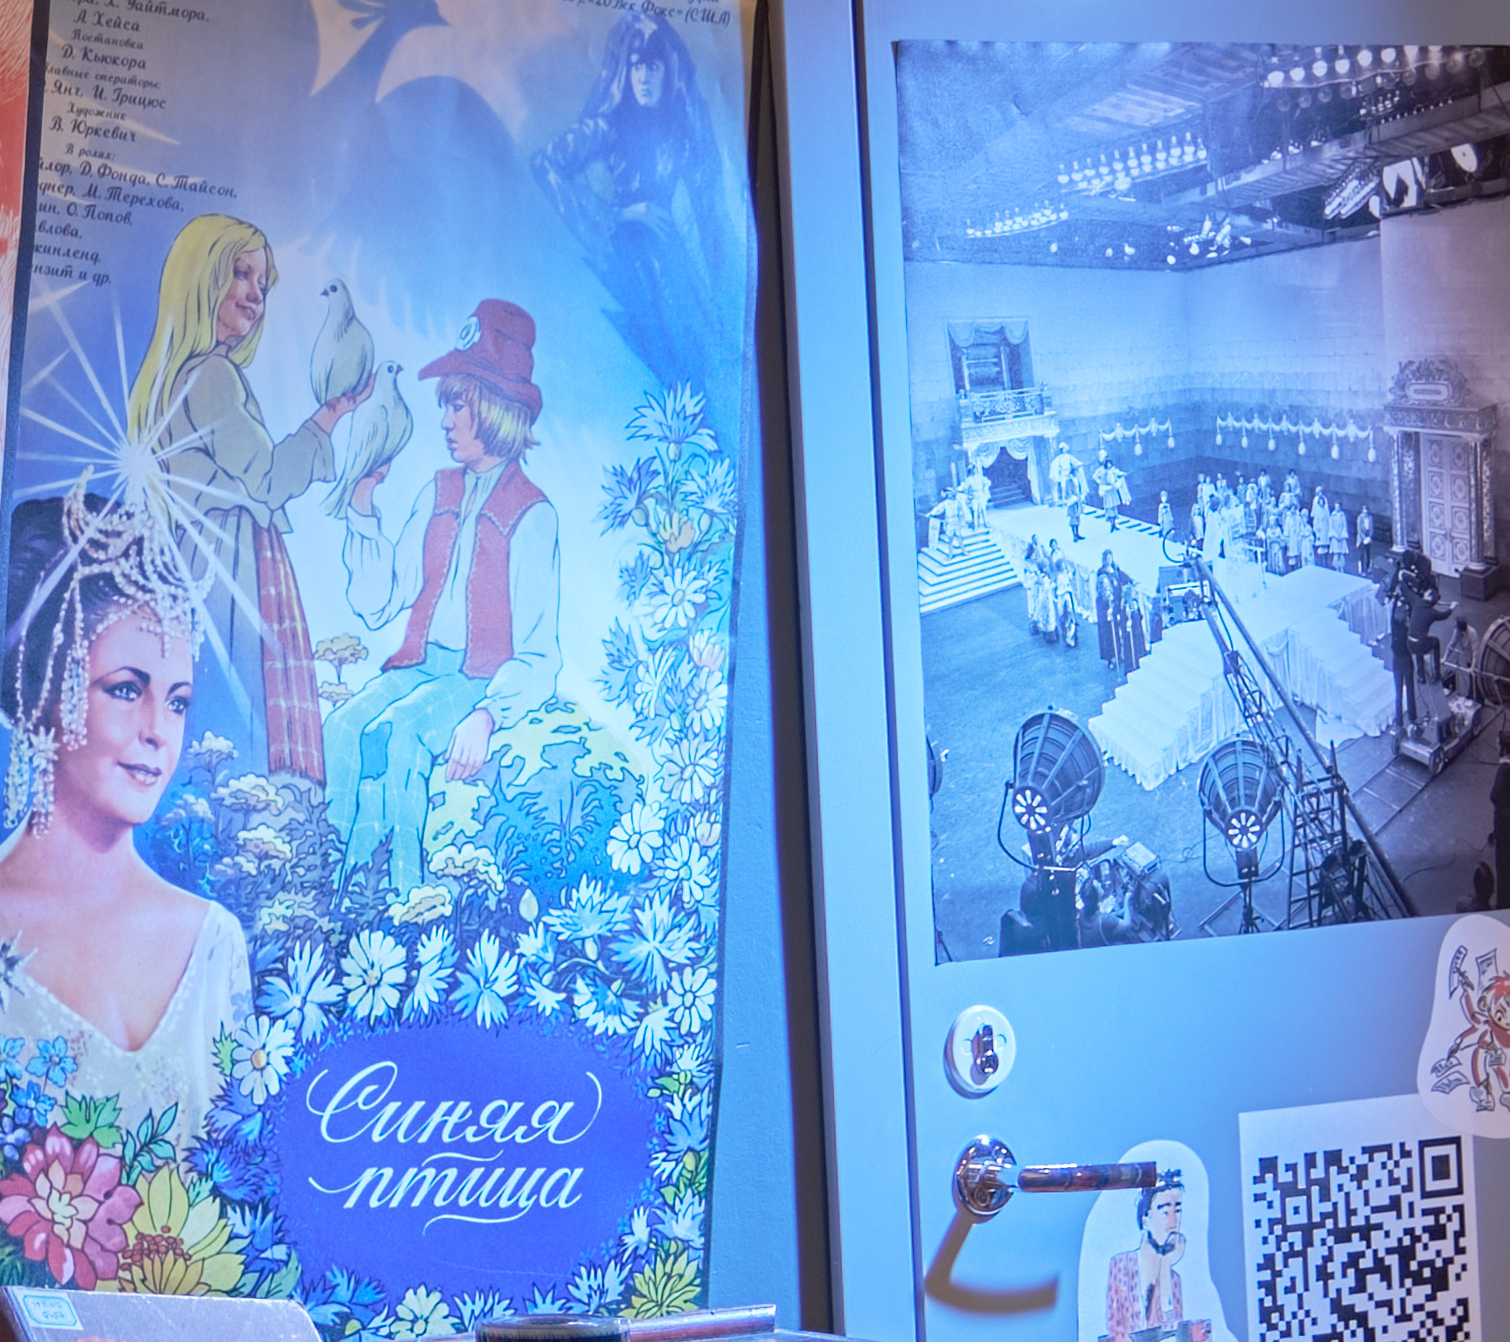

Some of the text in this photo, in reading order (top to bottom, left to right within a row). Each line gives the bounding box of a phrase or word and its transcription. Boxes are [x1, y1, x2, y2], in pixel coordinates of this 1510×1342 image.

[91, 11, 140, 32] Хейса
[71, 29, 144, 50] Постановка
[82, 46, 146, 71] Кьюкора
[67, 101, 127, 120] Художник
[70, 118, 136, 142] Юркевич
[107, 186, 184, 213] Терехова,
[306, 1061, 602, 1143] Синяя
[308, 1165, 584, 1227] птица
